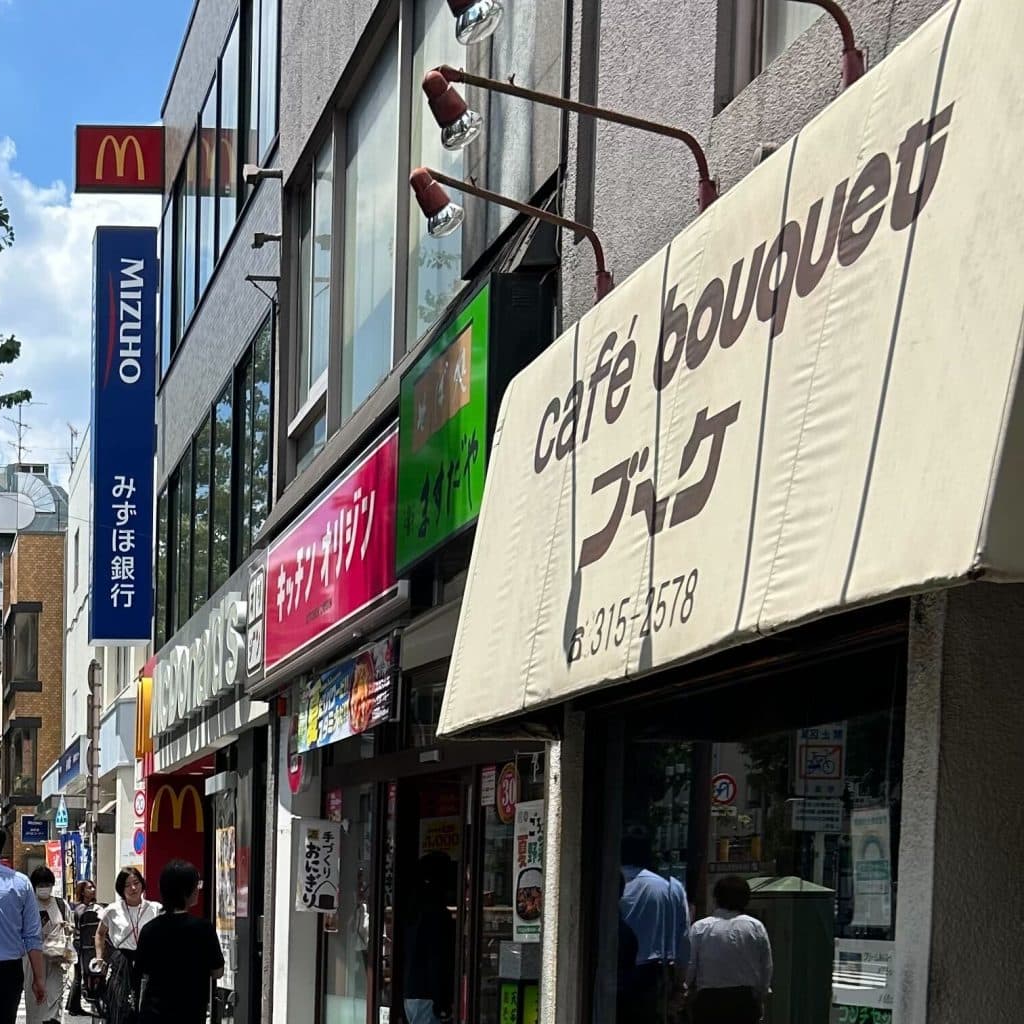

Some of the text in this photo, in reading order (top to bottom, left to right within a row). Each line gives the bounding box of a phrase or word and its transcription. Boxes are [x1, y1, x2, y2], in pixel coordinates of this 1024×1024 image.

[119, 257, 144, 384] MIZUHO
[533, 101, 956, 475] café bouquet
[110, 475, 137, 607] みずほ銀行
[578, 401, 741, 569] ブーケ
[590, 568, 698, 656] 315-2578
[303, 842, 321, 908] おにぎり
[322, 831, 335, 879] 手づくり
